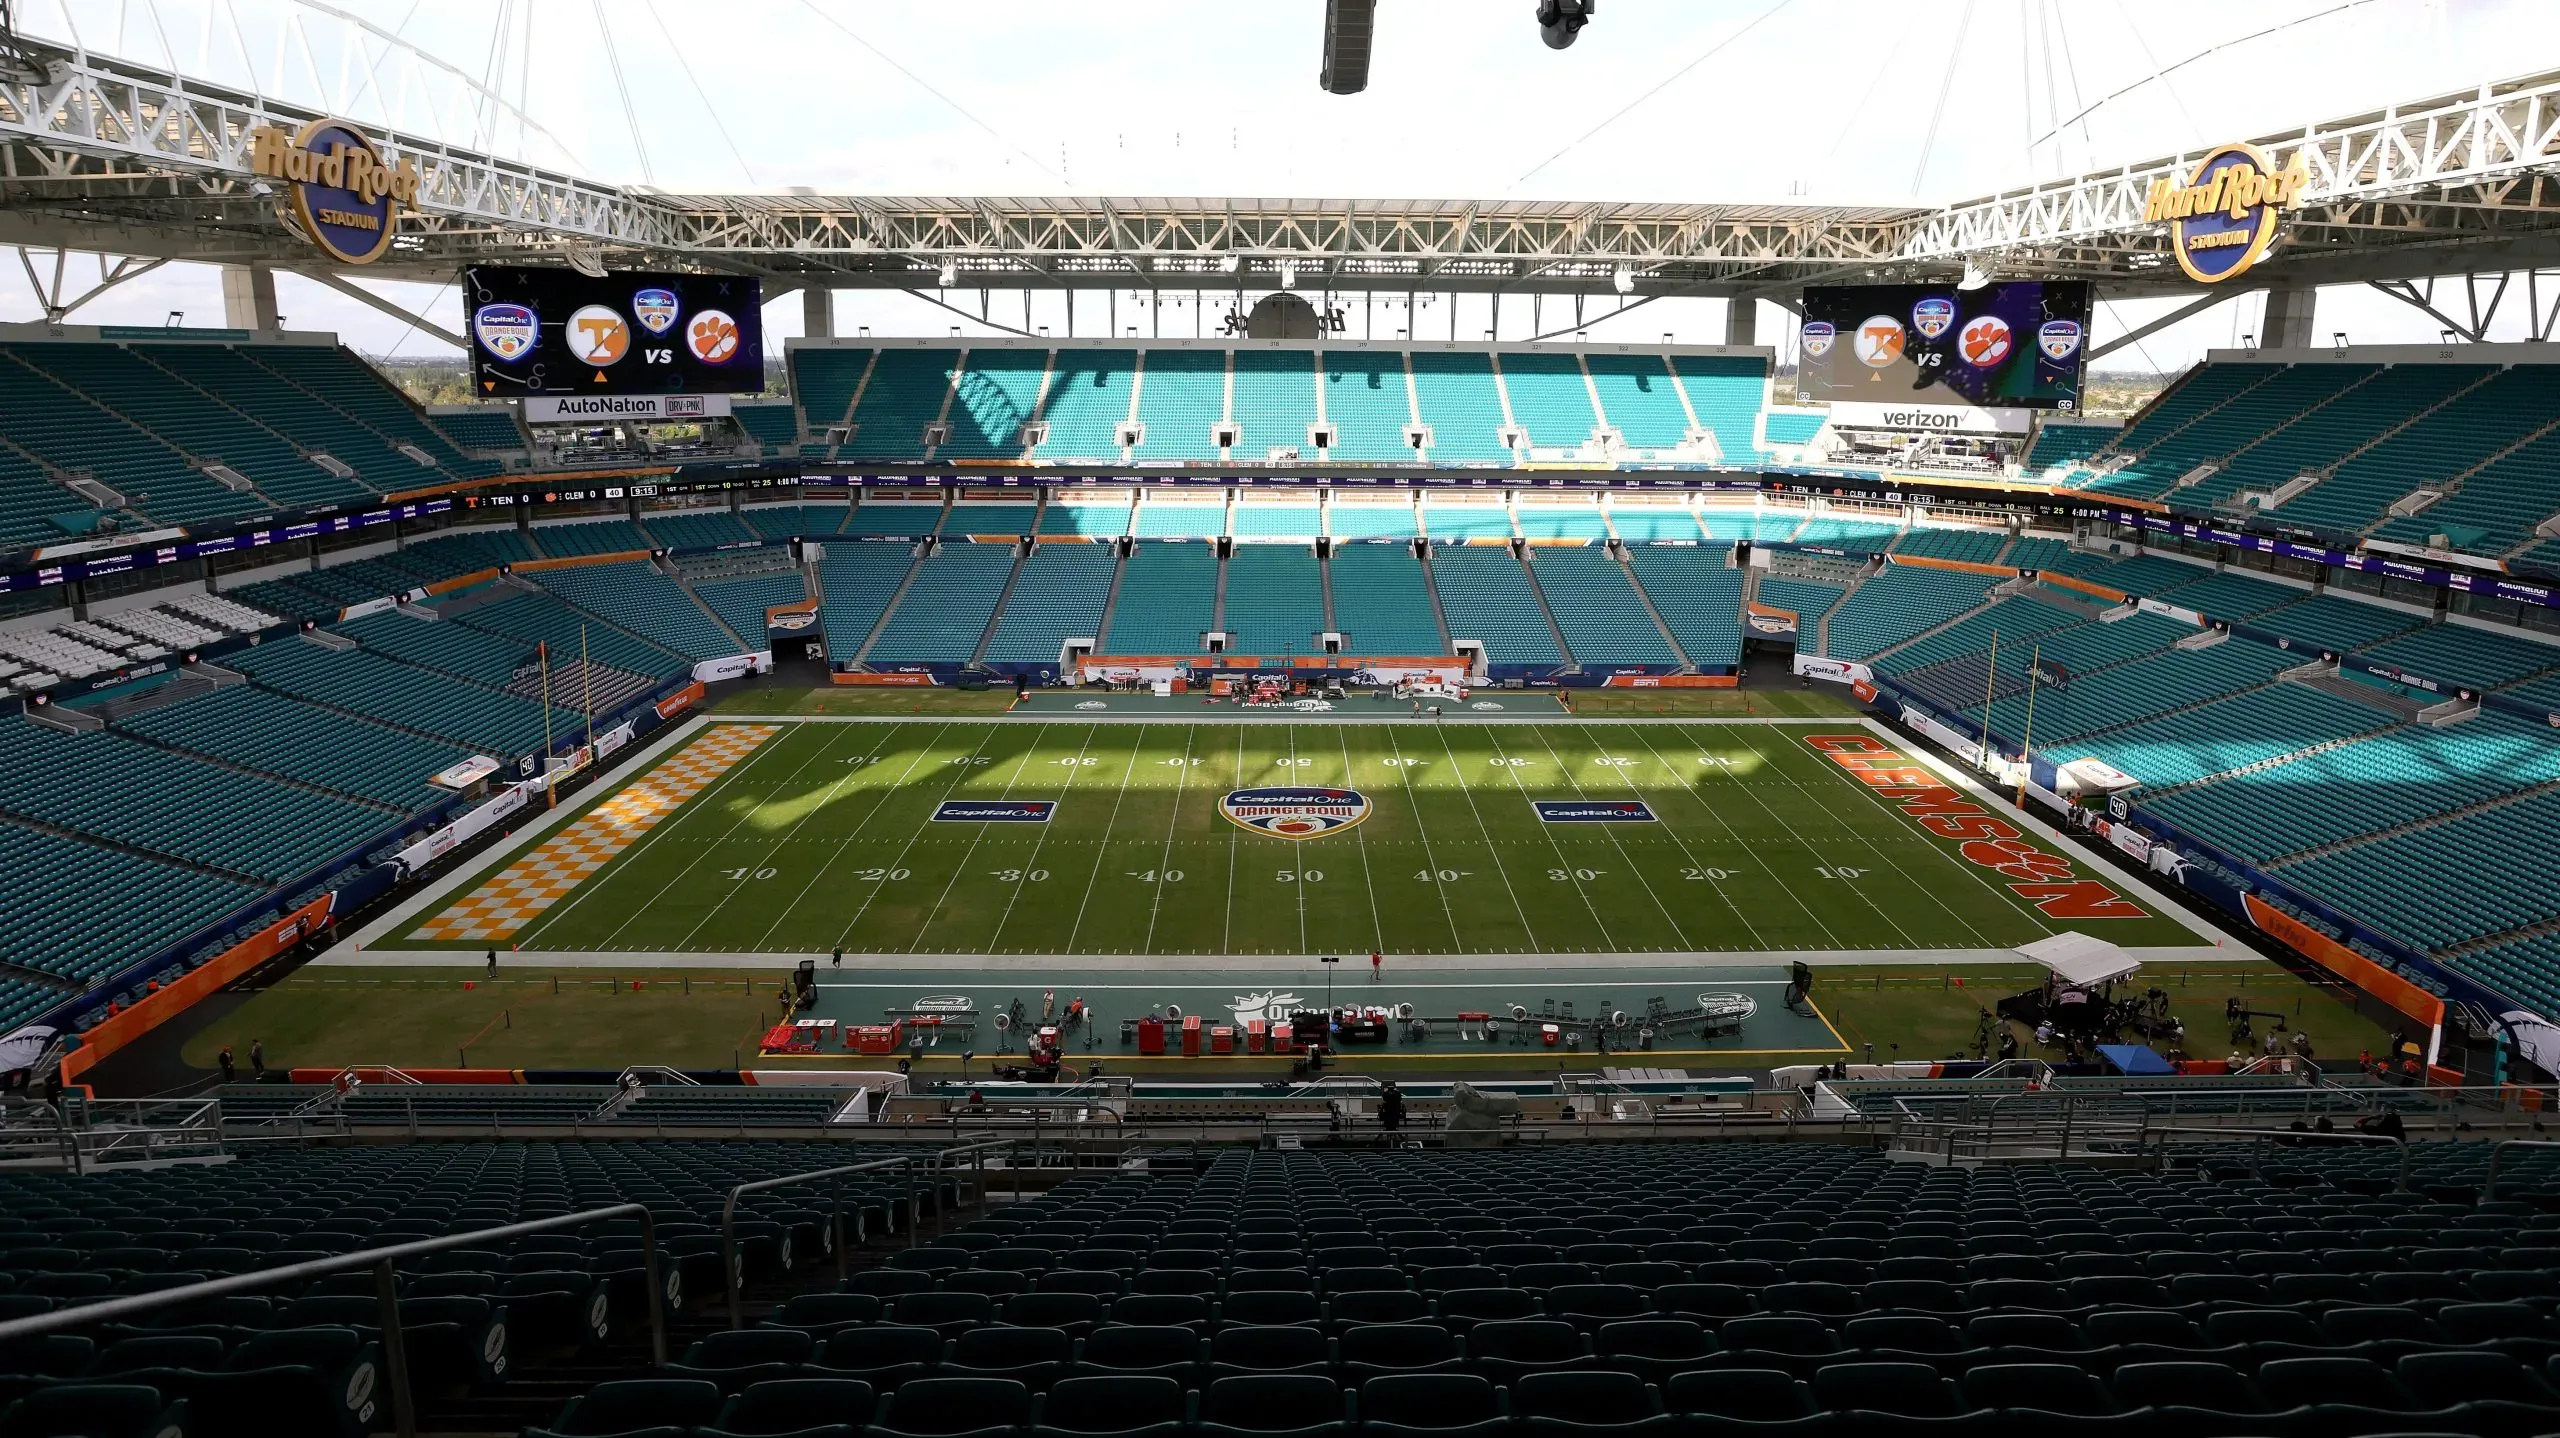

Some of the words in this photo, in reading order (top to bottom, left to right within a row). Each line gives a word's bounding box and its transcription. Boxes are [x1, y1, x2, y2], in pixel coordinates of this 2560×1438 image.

[253, 126, 345, 188] Hard
[345, 147, 421, 212] Rock
[2143, 167, 2228, 222] Hard
[2220, 152, 2310, 220] Rock
[319, 208, 379, 230] STADIUM
[2188, 230, 2250, 250] STADIUM
[557, 398, 656, 415] AutoNation
[1883, 410, 1959, 428] verizon
[491, 496, 513, 505] TEN
[522, 494, 529, 503] 0
[564, 491, 584, 501] CLEM
[589, 490, 596, 499] 0
[609, 488, 620, 497] 40
[634, 486, 653, 496] 9:15
[1791, 485, 1808, 494] TEN
[1849, 490, 1867, 499] CLEM
[1871, 491, 1877, 500] 0
[1913, 495, 1931, 504] 9:15
[2089, 510, 2100, 518] PM
[1633, 678, 1659, 687] ESPN
[663, 695, 688, 714] GOODYEAR
[1235, 807, 1302, 817] ORANGE
[1306, 807, 1355, 817] BOWL
[2112, 801, 2124, 815] 40
[727, 867, 778, 880] 10
[860, 868, 910, 880] 20
[1000, 869, 1049, 882] 30
[1138, 869, 1184, 882] 40
[1276, 869, 1323, 882] 50
[1413, 869, 1458, 882] 40
[1547, 868, 1595, 881] 30
[1680, 868, 1727, 880] 20
[1813, 867, 1859, 880] 10
